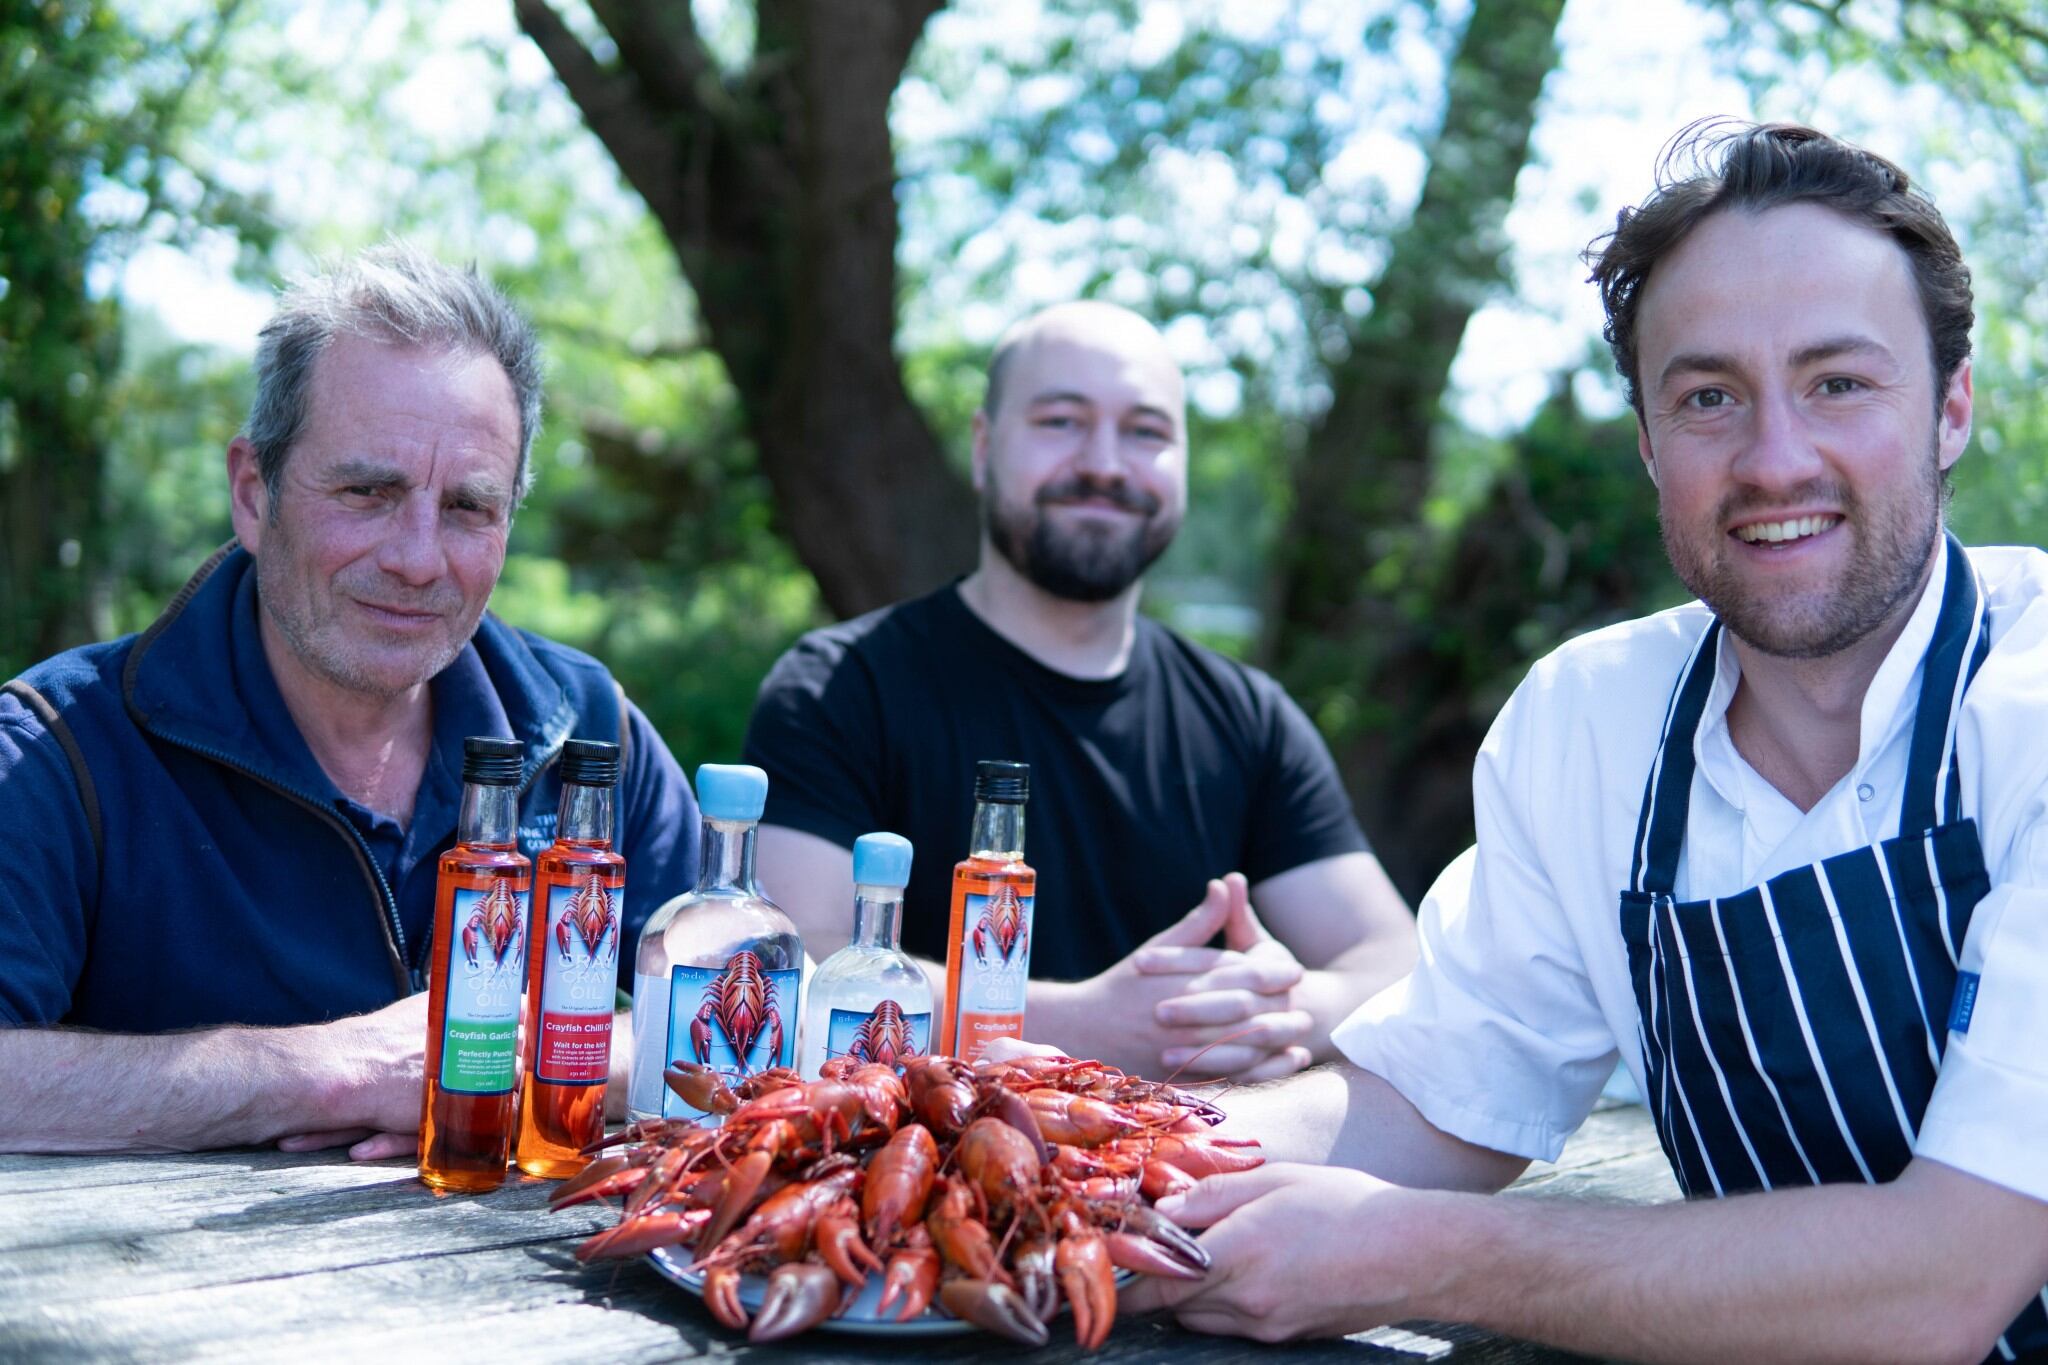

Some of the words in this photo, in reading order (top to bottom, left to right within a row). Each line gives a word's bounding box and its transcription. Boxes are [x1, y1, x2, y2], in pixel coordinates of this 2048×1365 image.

[527, 839, 555, 850] COM
[562, 971, 608, 984] CRAY
[979, 973, 1019, 985] CRAY
[468, 977, 513, 991] CRAY
[570, 986, 602, 1000] OIL
[985, 988, 1014, 1000] OIL
[477, 993, 508, 1007] OIL
[546, 1022, 582, 1032] Crayfish
[584, 1024, 604, 1032] Chilli
[974, 1022, 1007, 1032] Crayfish
[449, 1029, 487, 1040] Crayfish
[489, 1032, 511, 1040] Garlic
[553, 1041, 570, 1049] Wait
[458, 1049, 491, 1058] Perfectly
